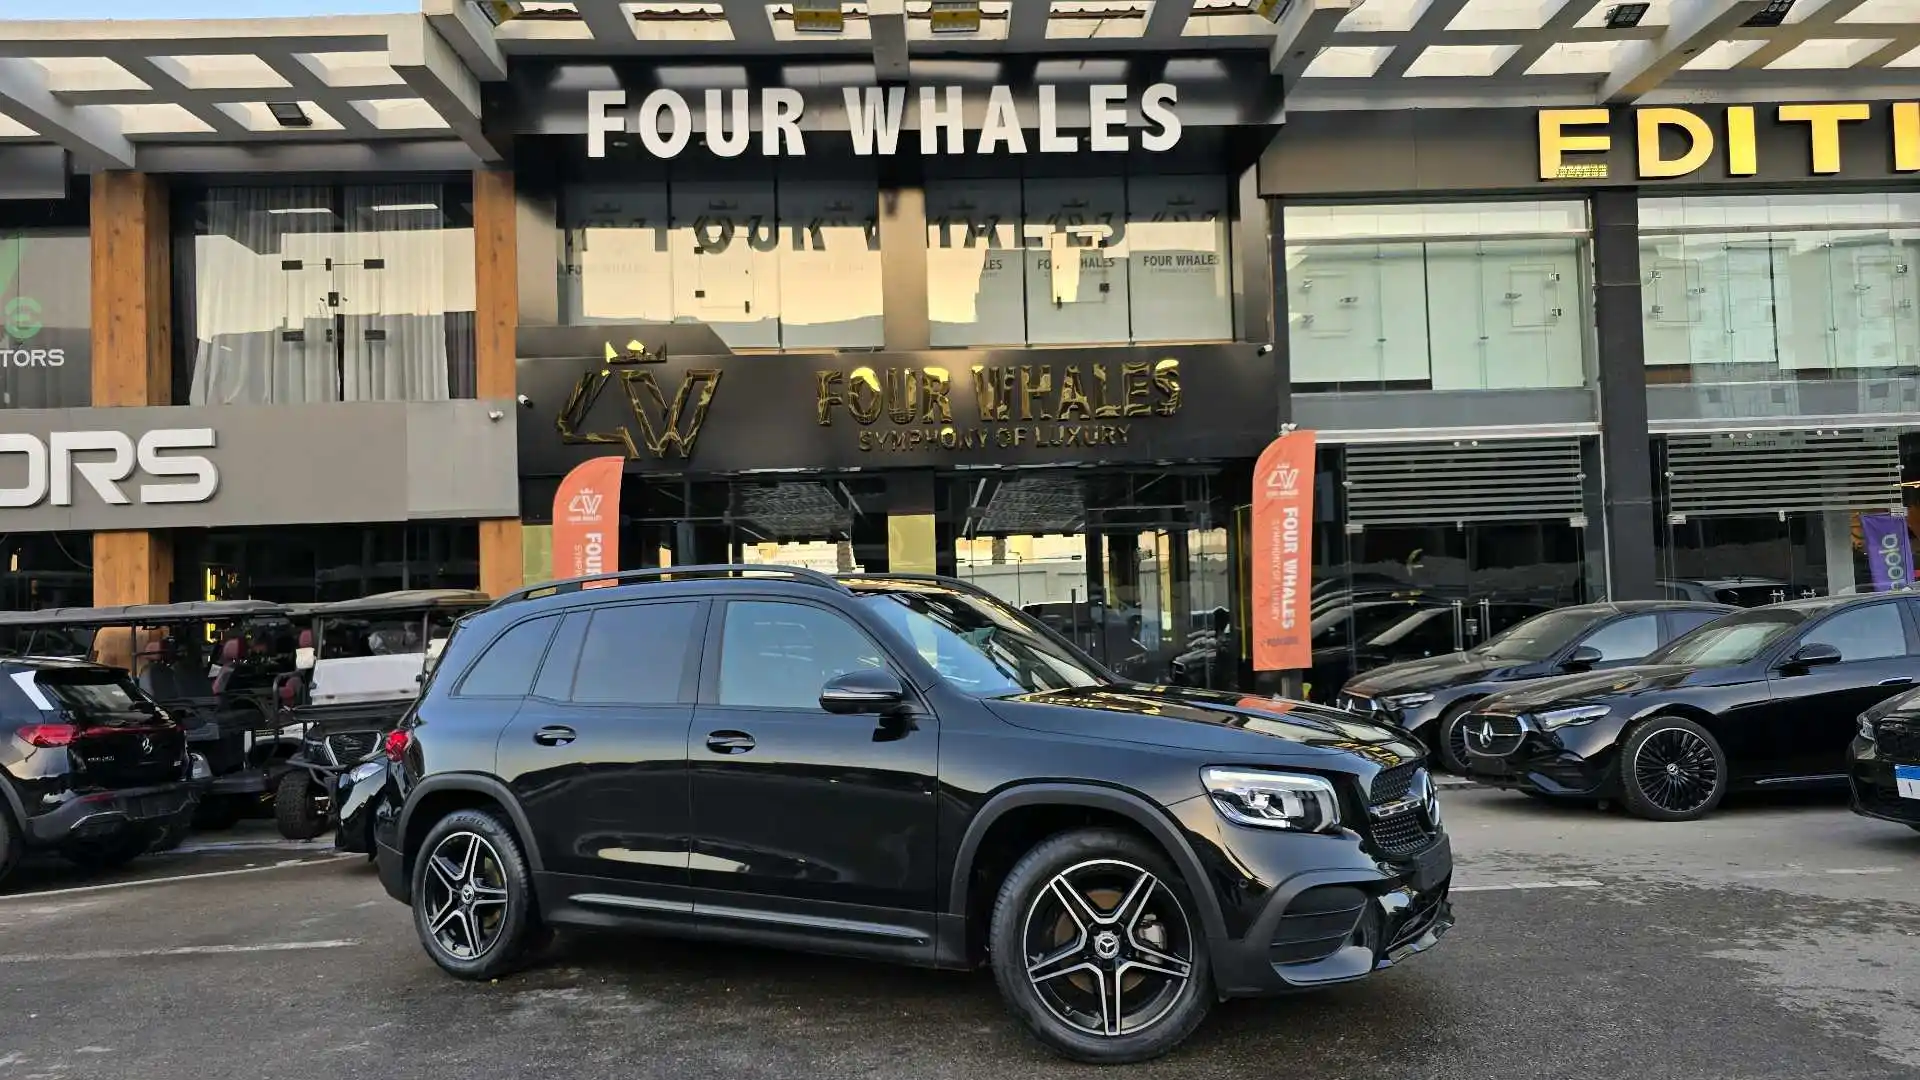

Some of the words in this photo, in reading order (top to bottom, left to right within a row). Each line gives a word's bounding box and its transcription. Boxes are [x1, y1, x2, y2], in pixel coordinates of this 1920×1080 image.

[588, 88, 806, 158] FOUR
[842, 83, 1182, 155] WHALES
[1080, 257, 1114, 269] HALES
[1143, 255, 1173, 267] FOUR
[1177, 254, 1219, 266] WHALES
[0, 349, 65, 367] TORS
[816, 366, 952, 425] FOUR
[971, 359, 1182, 422] WHALES
[858, 427, 988, 452] SYMPHONY
[996, 427, 1027, 449] OF
[1034, 424, 1131, 446] LUXURY
[1283, 506, 1298, 553] FOUR
[1282, 559, 1298, 630] WHALES
